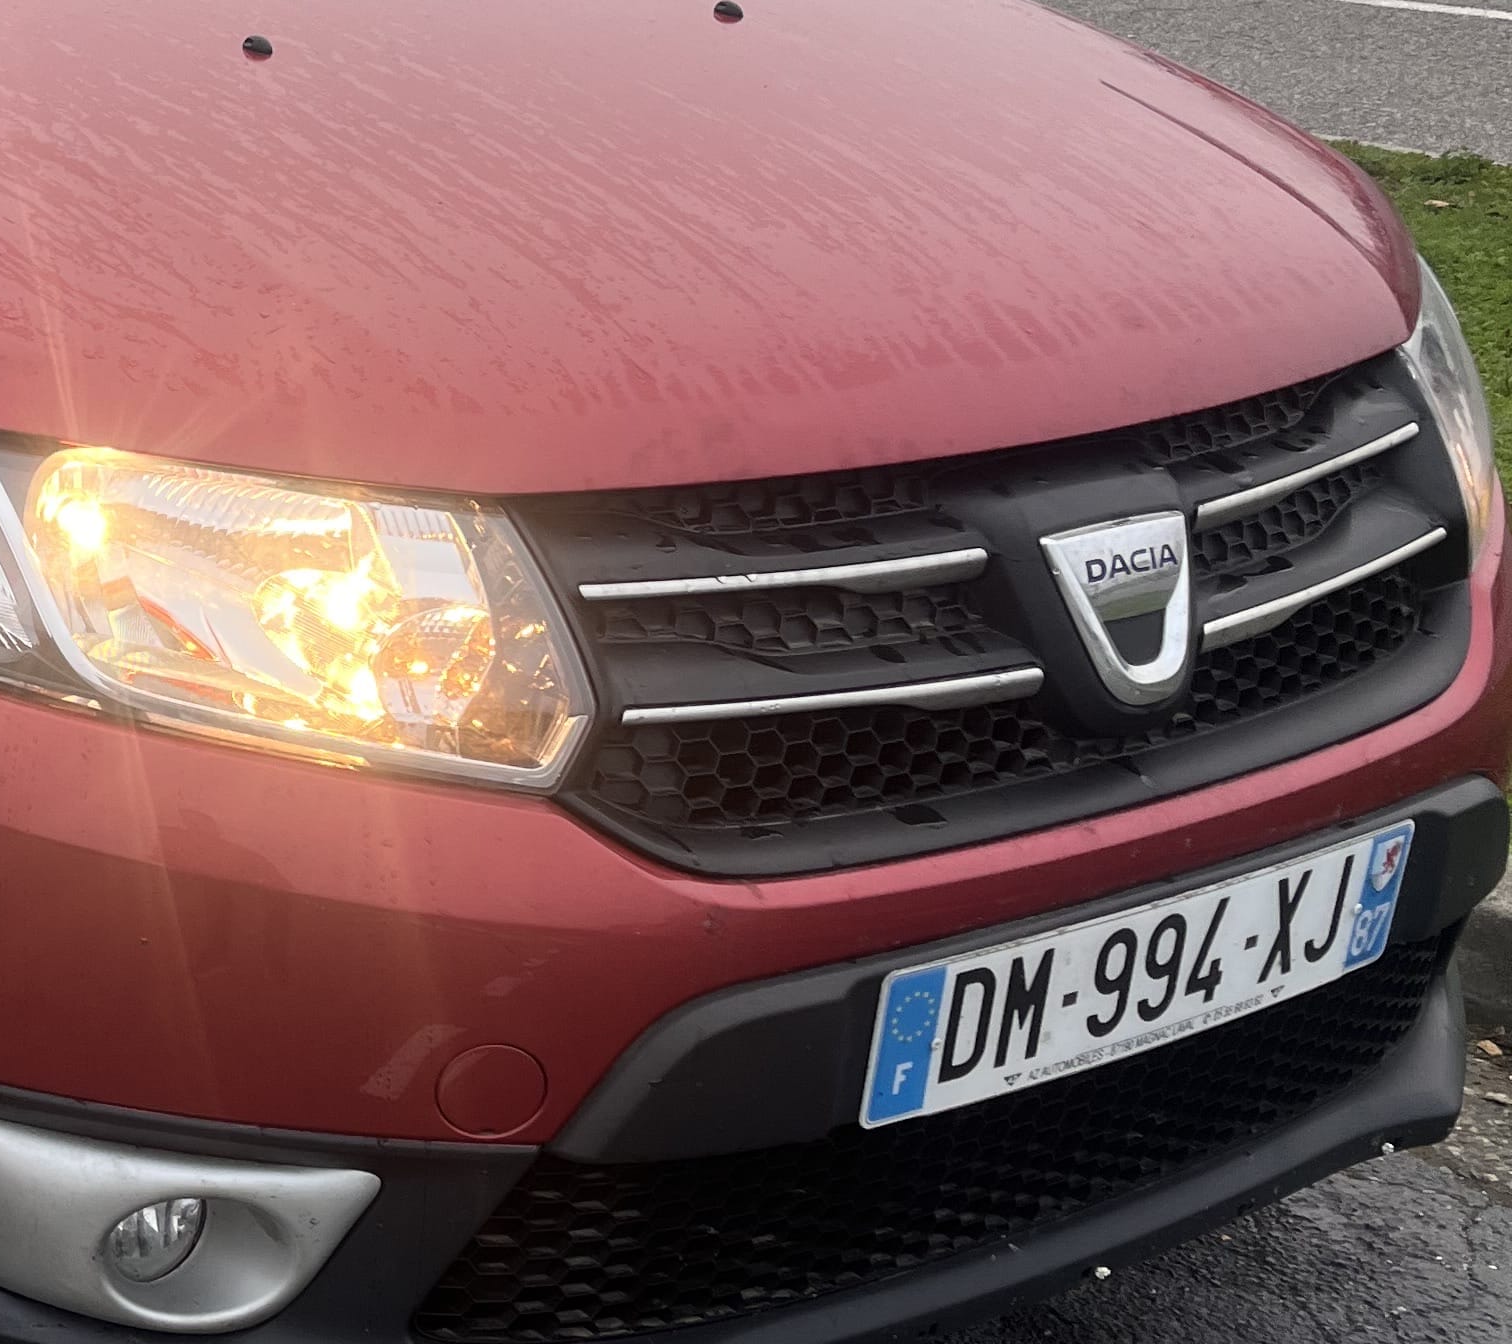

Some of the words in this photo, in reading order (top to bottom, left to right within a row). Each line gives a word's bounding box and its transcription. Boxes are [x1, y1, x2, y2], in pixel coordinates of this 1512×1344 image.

[1085, 543, 1178, 583] DACIA
[1351, 902, 1391, 956] 87
[937, 854, 1356, 1084] DM-994-XJ
[892, 1061, 914, 1095] F
